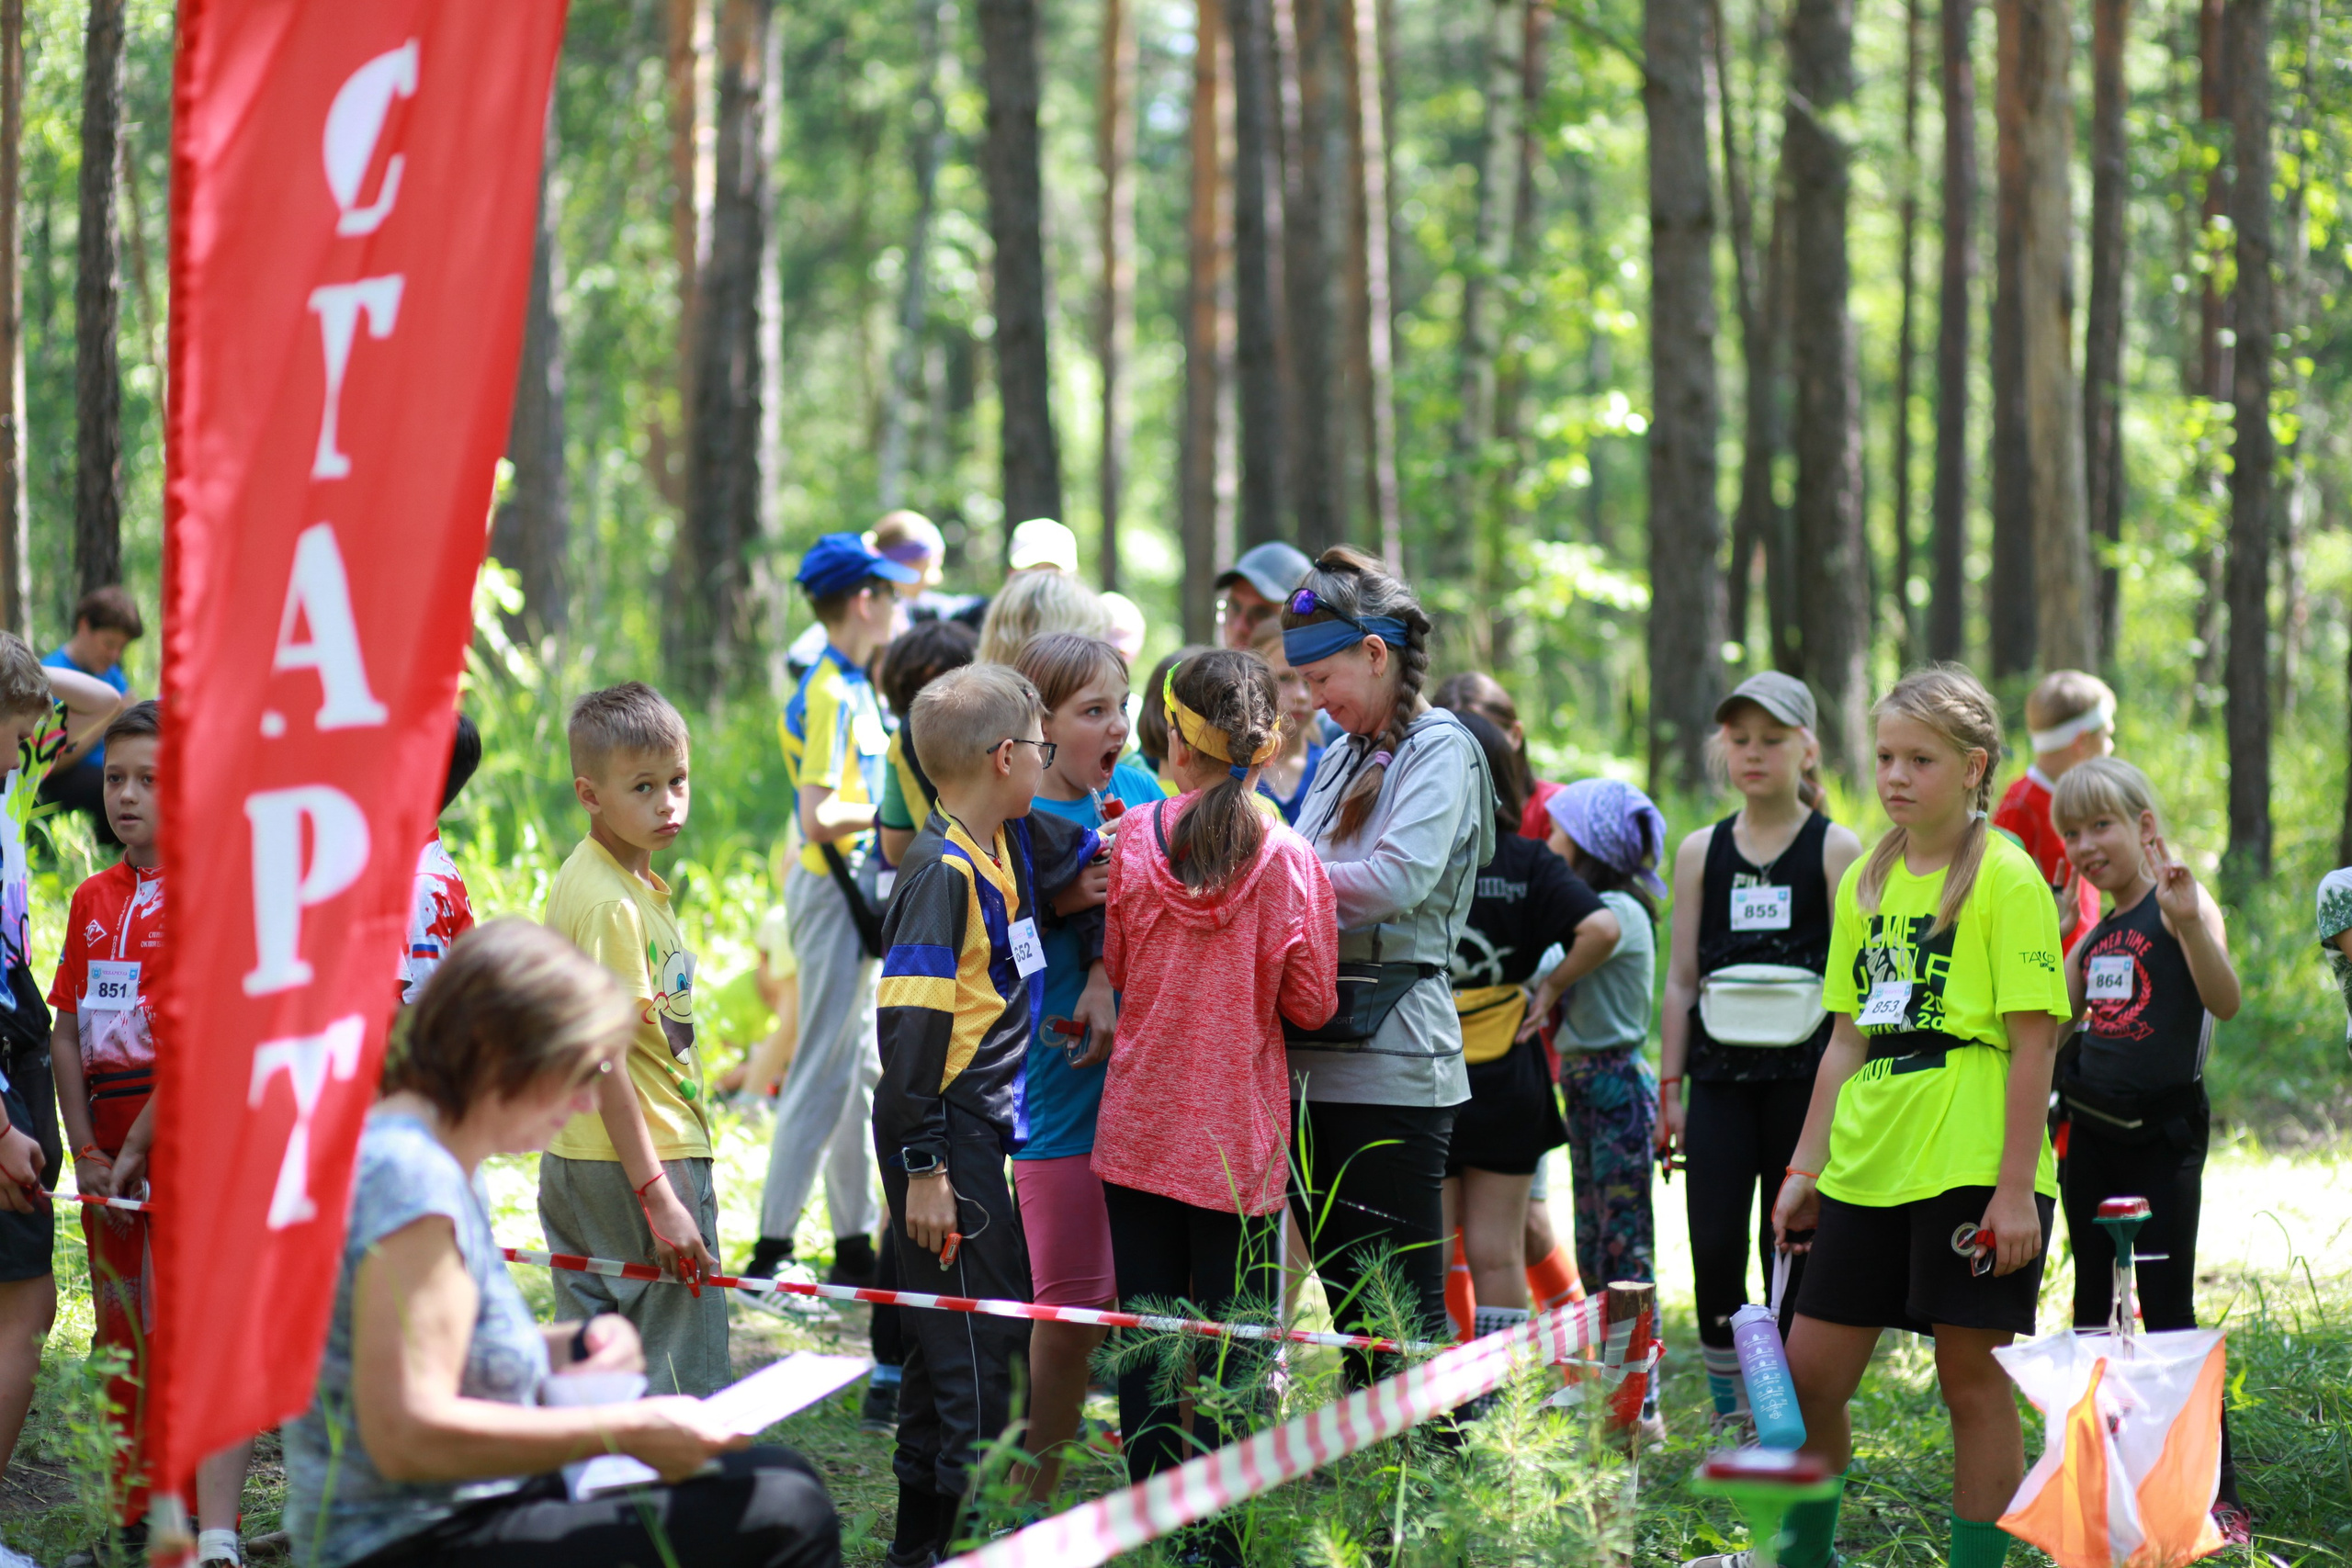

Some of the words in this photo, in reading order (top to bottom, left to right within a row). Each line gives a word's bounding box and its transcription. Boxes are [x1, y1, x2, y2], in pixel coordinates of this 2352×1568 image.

[243, 39, 419, 1231] СТАРТ
[1744, 904, 1778, 919] 855
[1013, 942, 1034, 963] 852
[2096, 975, 2123, 988] 864
[98, 982, 128, 998] 851
[1871, 999, 1901, 1015] 853
